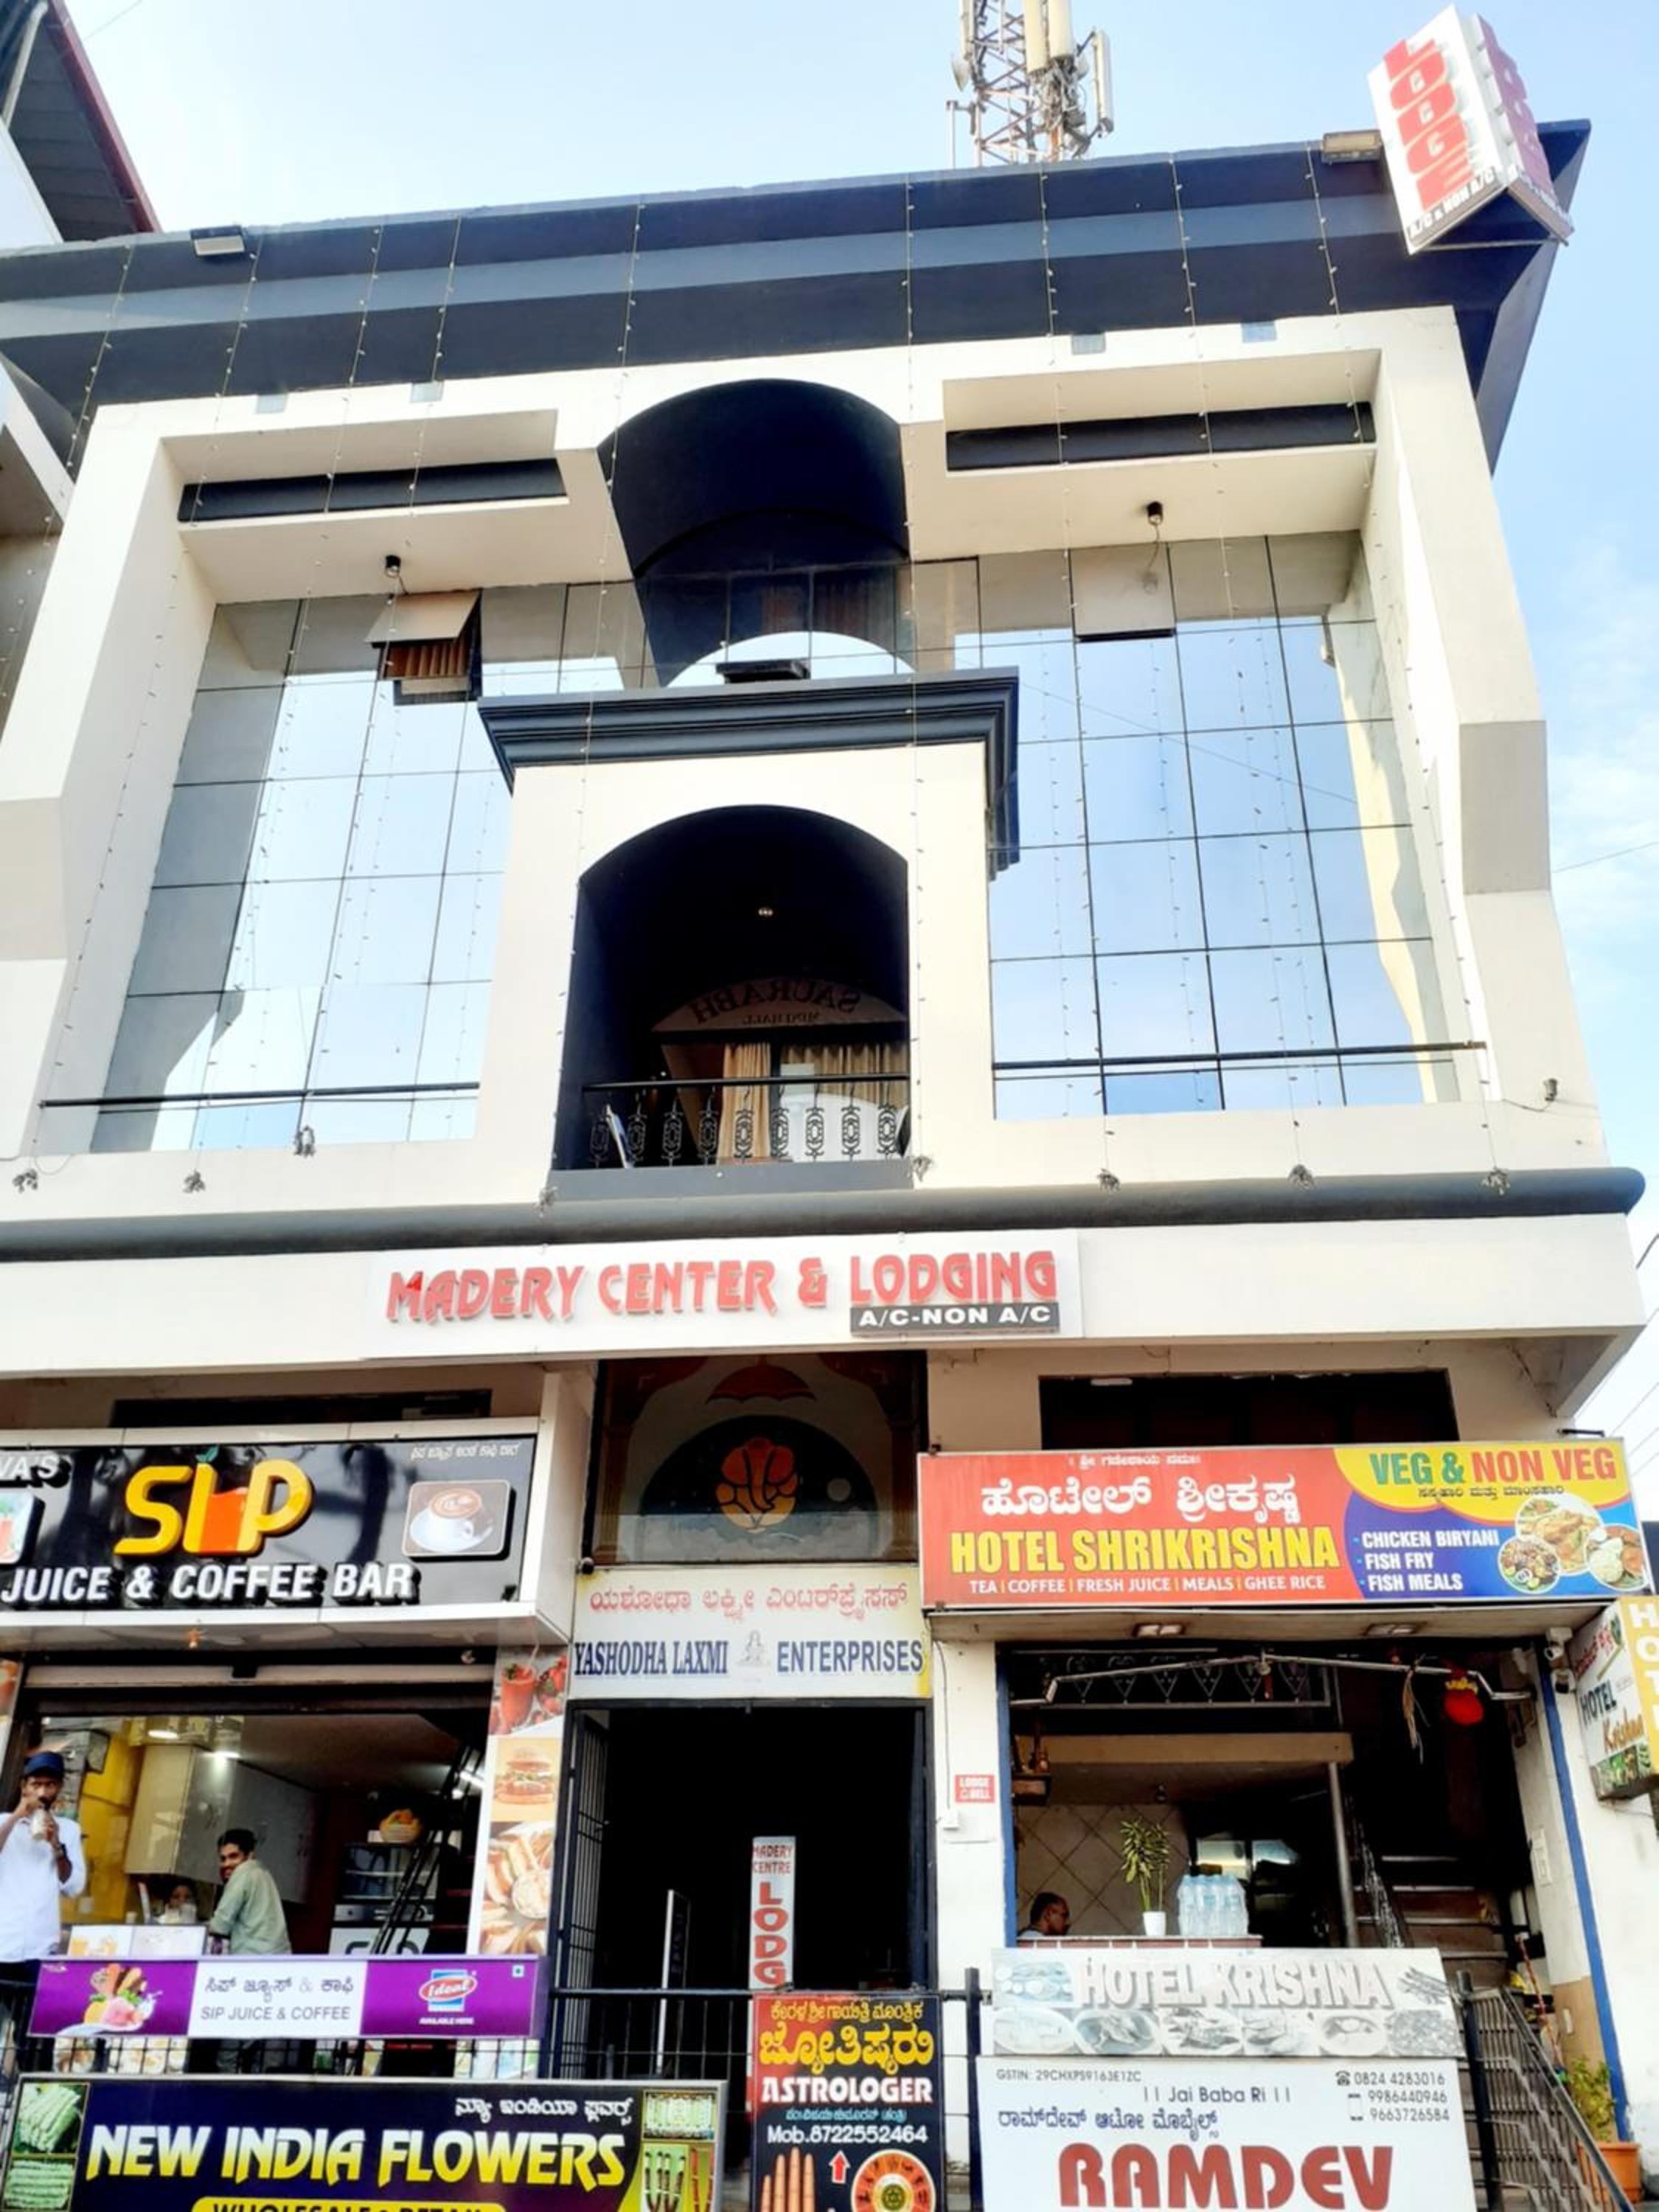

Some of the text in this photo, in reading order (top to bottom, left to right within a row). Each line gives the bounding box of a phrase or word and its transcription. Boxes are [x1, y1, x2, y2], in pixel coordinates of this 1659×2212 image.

[1383, 39, 1474, 212] LODGE
[386, 1251, 1058, 1323] MADERY CENTER & LODGING
[859, 1305, 1051, 1326] A/C-NON A/C
[1369, 1447, 1617, 1486] VEG & NON VEG
[1176, 1472, 1301, 1524] ಶ್ರೀಕೃಷ್ಣ
[950, 1526, 1340, 1575] HOTEL SHRIKRISHNA
[1361, 1528, 1500, 1549] CHICKEN BIRYANI
[1365, 1551, 1435, 1571] FISH FRY
[1, 1562, 413, 1602] JUICE & COFFEE BAR
[970, 1575, 1326, 1594] TEA COFFEE FRESH JUICE MEALS GHEE RICE
[1368, 1573, 1464, 1592] FISH MEALS
[574, 1640, 923, 1677] YASHODHA LAXMI ENTERPRISES
[1580, 1679, 1617, 1726] HOTEL
[752, 1861, 791, 1874] CENTRE
[1082, 1960, 1396, 2010] HOTEL KRISHNA
[201, 2006, 351, 2020] SIP JUICE & COFFEE
[761, 2076, 933, 2103] ASTROLOGER
[1354, 2071, 1446, 2086] 0824 4283016
[1168, 2086, 1194, 2103] Jai
[1198, 2086, 1245, 2103] Baba
[1251, 2086, 1266, 2103] Ri
[1367, 2090, 1447, 2104] 9986440946
[1369, 2107, 1450, 2121] 9663726584
[86, 2125, 627, 2193] NEW INDIA FLOWERS
[1059, 2142, 1393, 2211] RAMDEV
